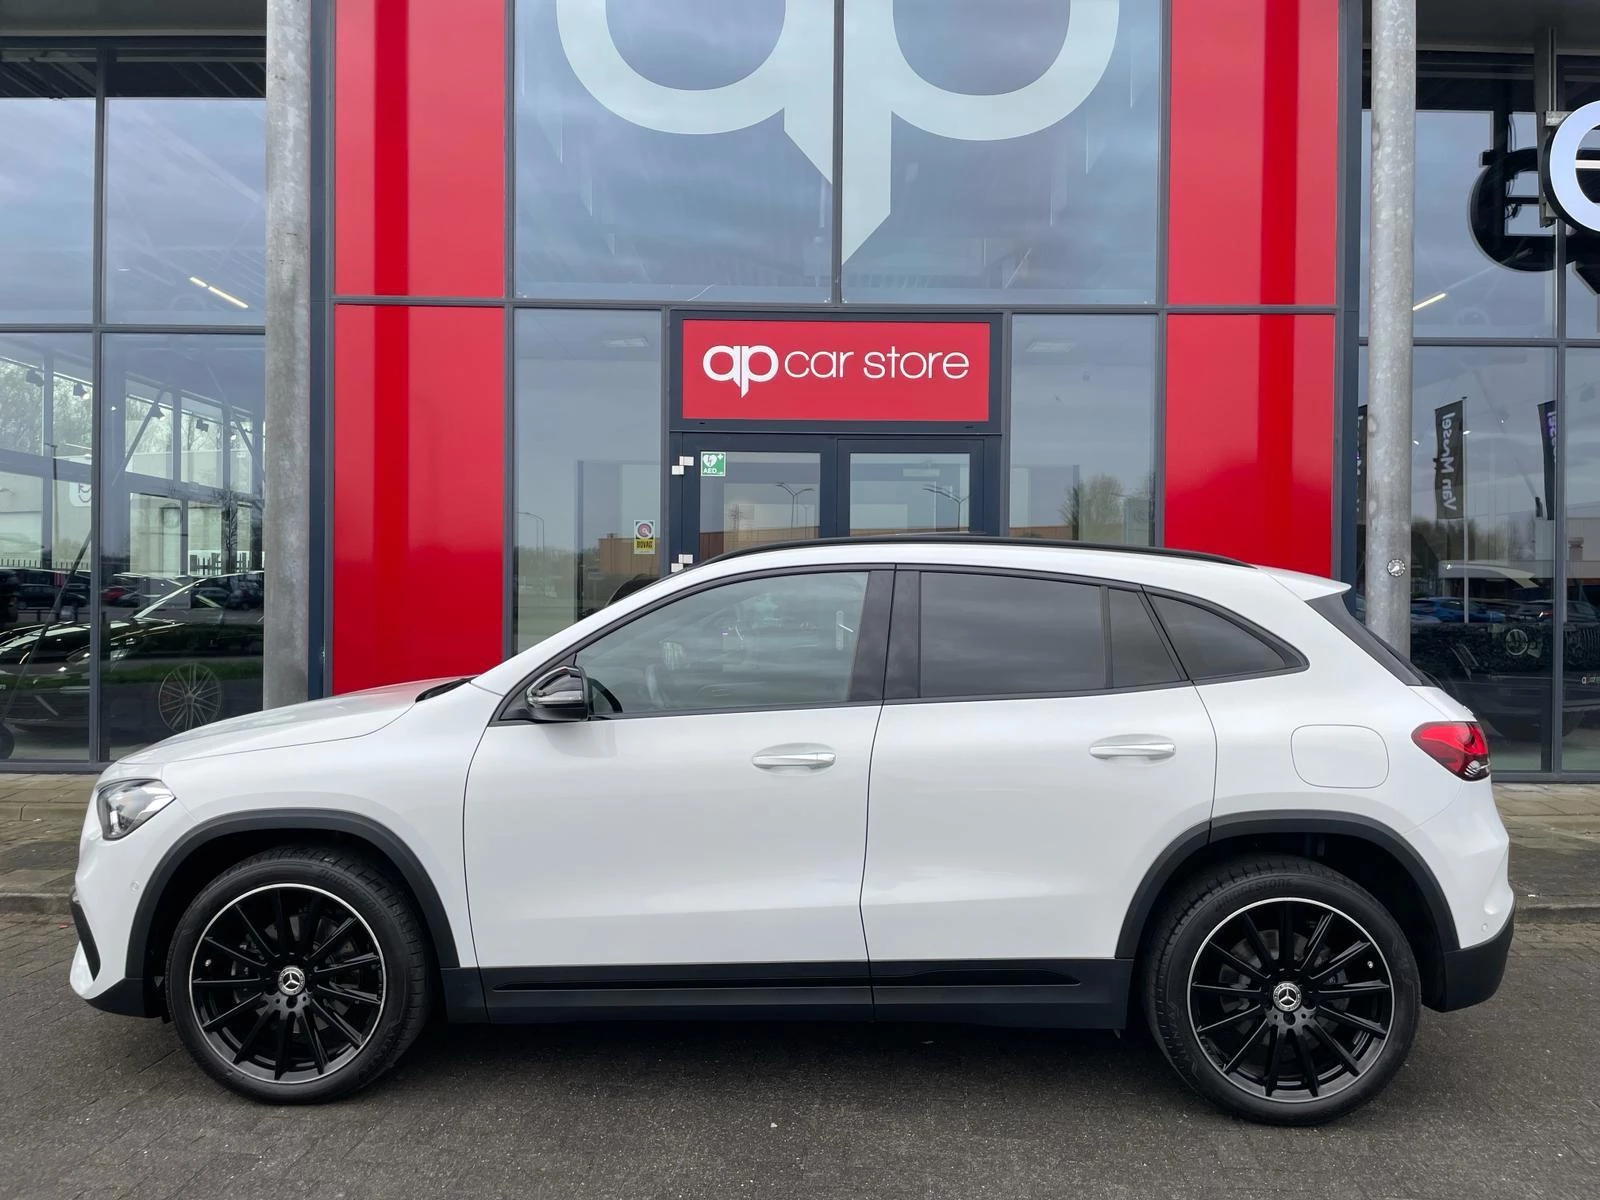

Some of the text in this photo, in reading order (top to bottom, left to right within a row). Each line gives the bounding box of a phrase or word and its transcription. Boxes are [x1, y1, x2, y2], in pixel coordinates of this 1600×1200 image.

[702, 345, 970, 398] ap car store
